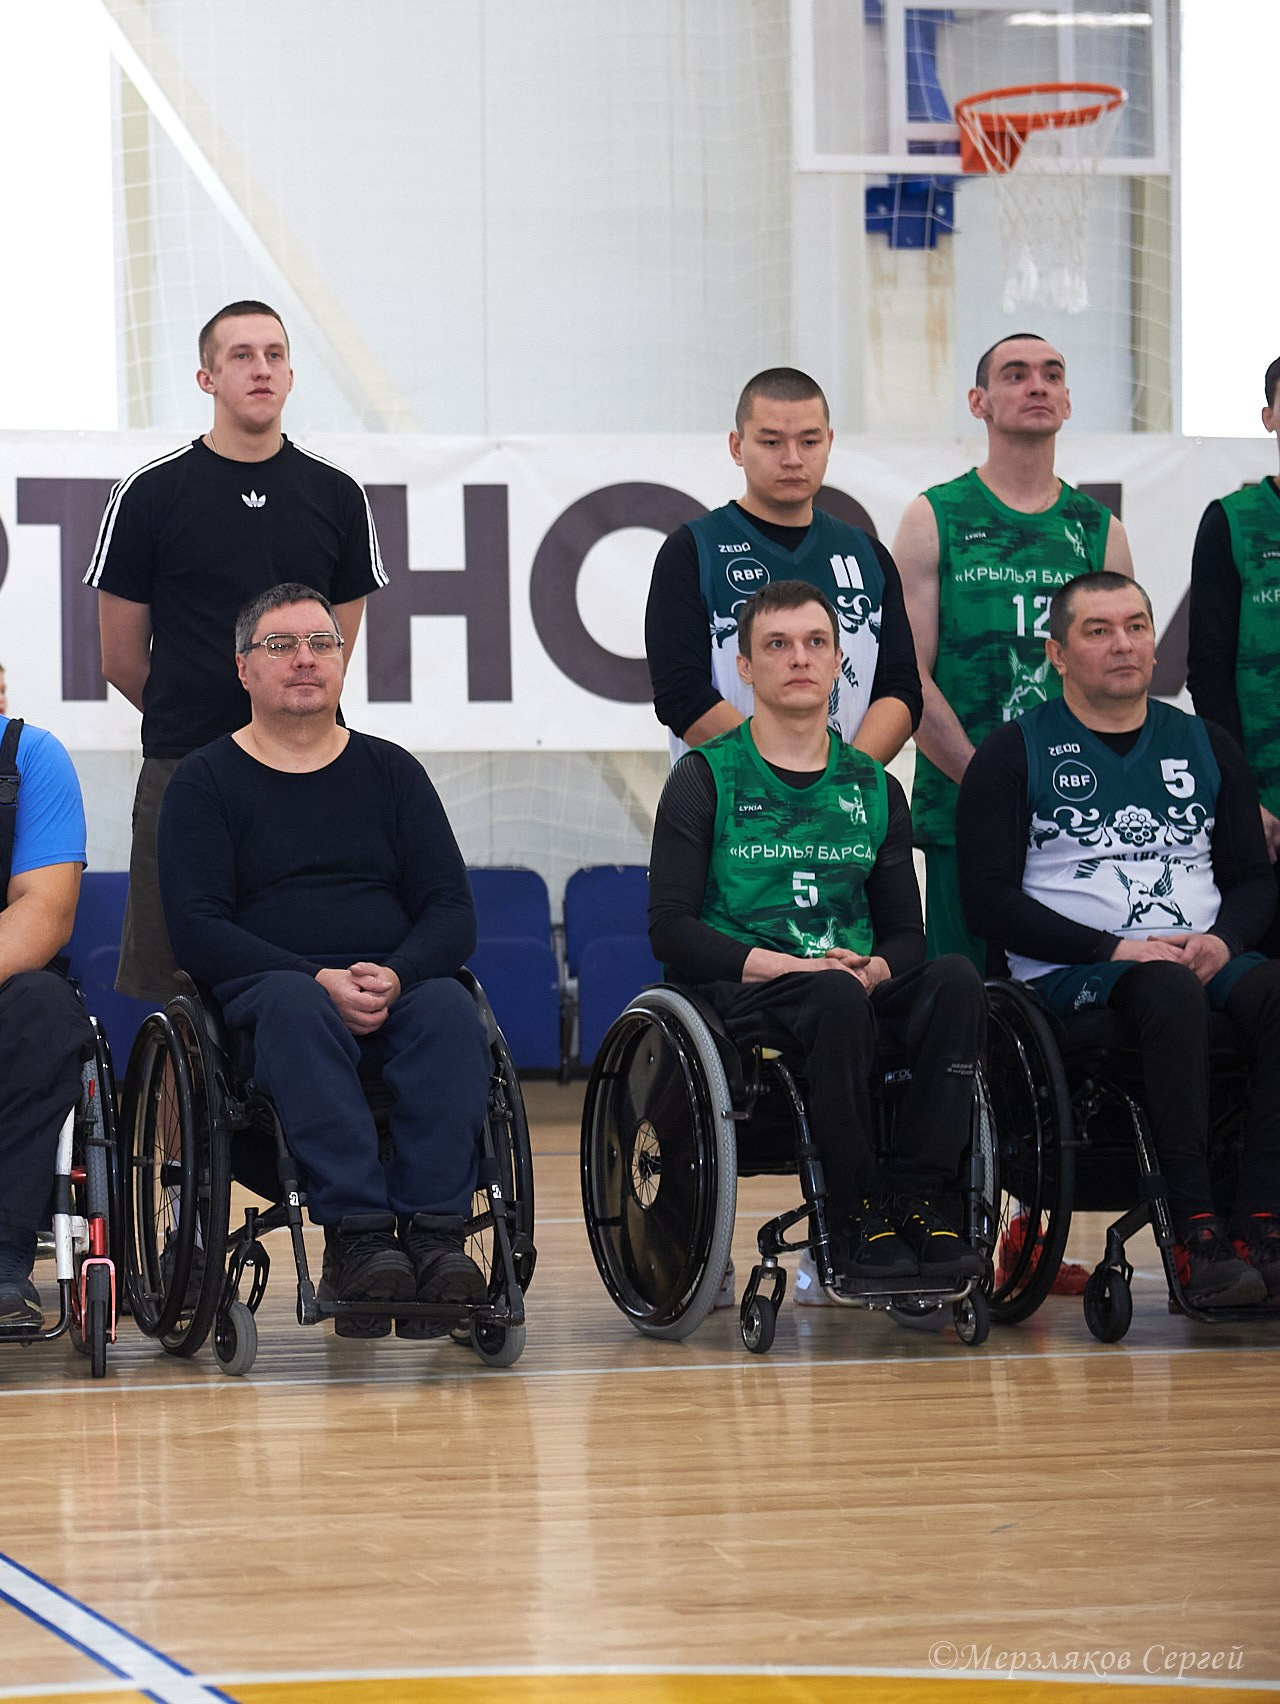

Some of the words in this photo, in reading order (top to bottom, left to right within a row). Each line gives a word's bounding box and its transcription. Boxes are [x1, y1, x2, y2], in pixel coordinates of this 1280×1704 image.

[732, 568, 764, 582] RBF
[829, 554, 865, 590] 11
[955, 567, 1037, 584] «КРЫЛЬЯ
[1012, 593, 1053, 639] 12
[1059, 774, 1091, 788] RBF
[1160, 758, 1196, 799] 5
[730, 844, 814, 859] «КРЫЛЬЯ
[792, 871, 819, 908] 5
